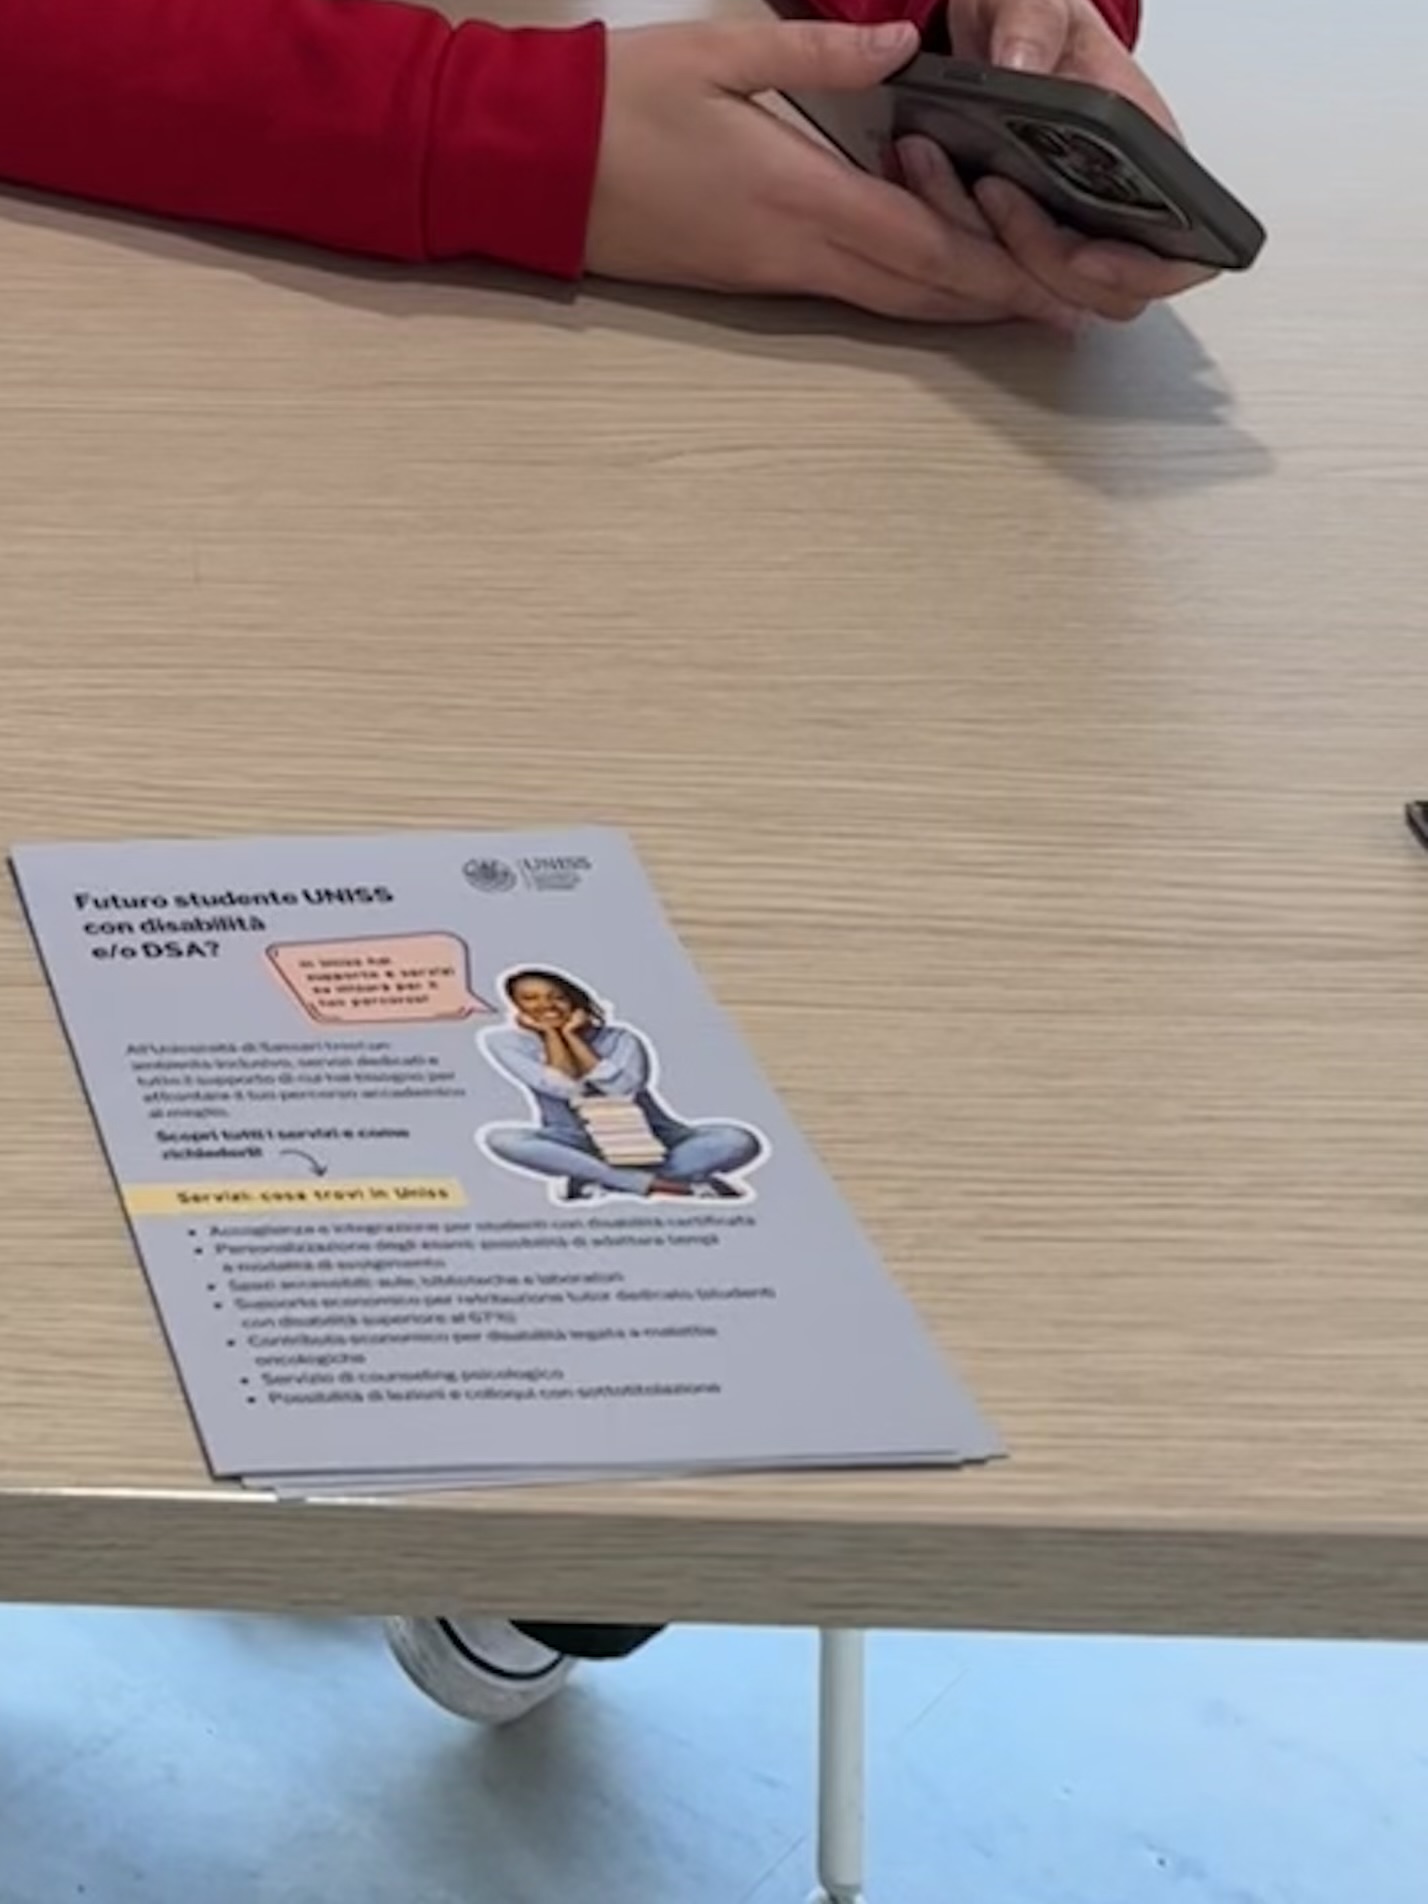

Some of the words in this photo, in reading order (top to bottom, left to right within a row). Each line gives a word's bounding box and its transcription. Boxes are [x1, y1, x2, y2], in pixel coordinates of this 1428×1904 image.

[73, 892, 168, 908] Futuro
[172, 889, 299, 906] studente
[302, 887, 395, 903] UNISS
[82, 921, 134, 934] con
[138, 916, 267, 933] disabilità
[90, 943, 137, 959] e/o
[142, 941, 223, 957] DSA?
